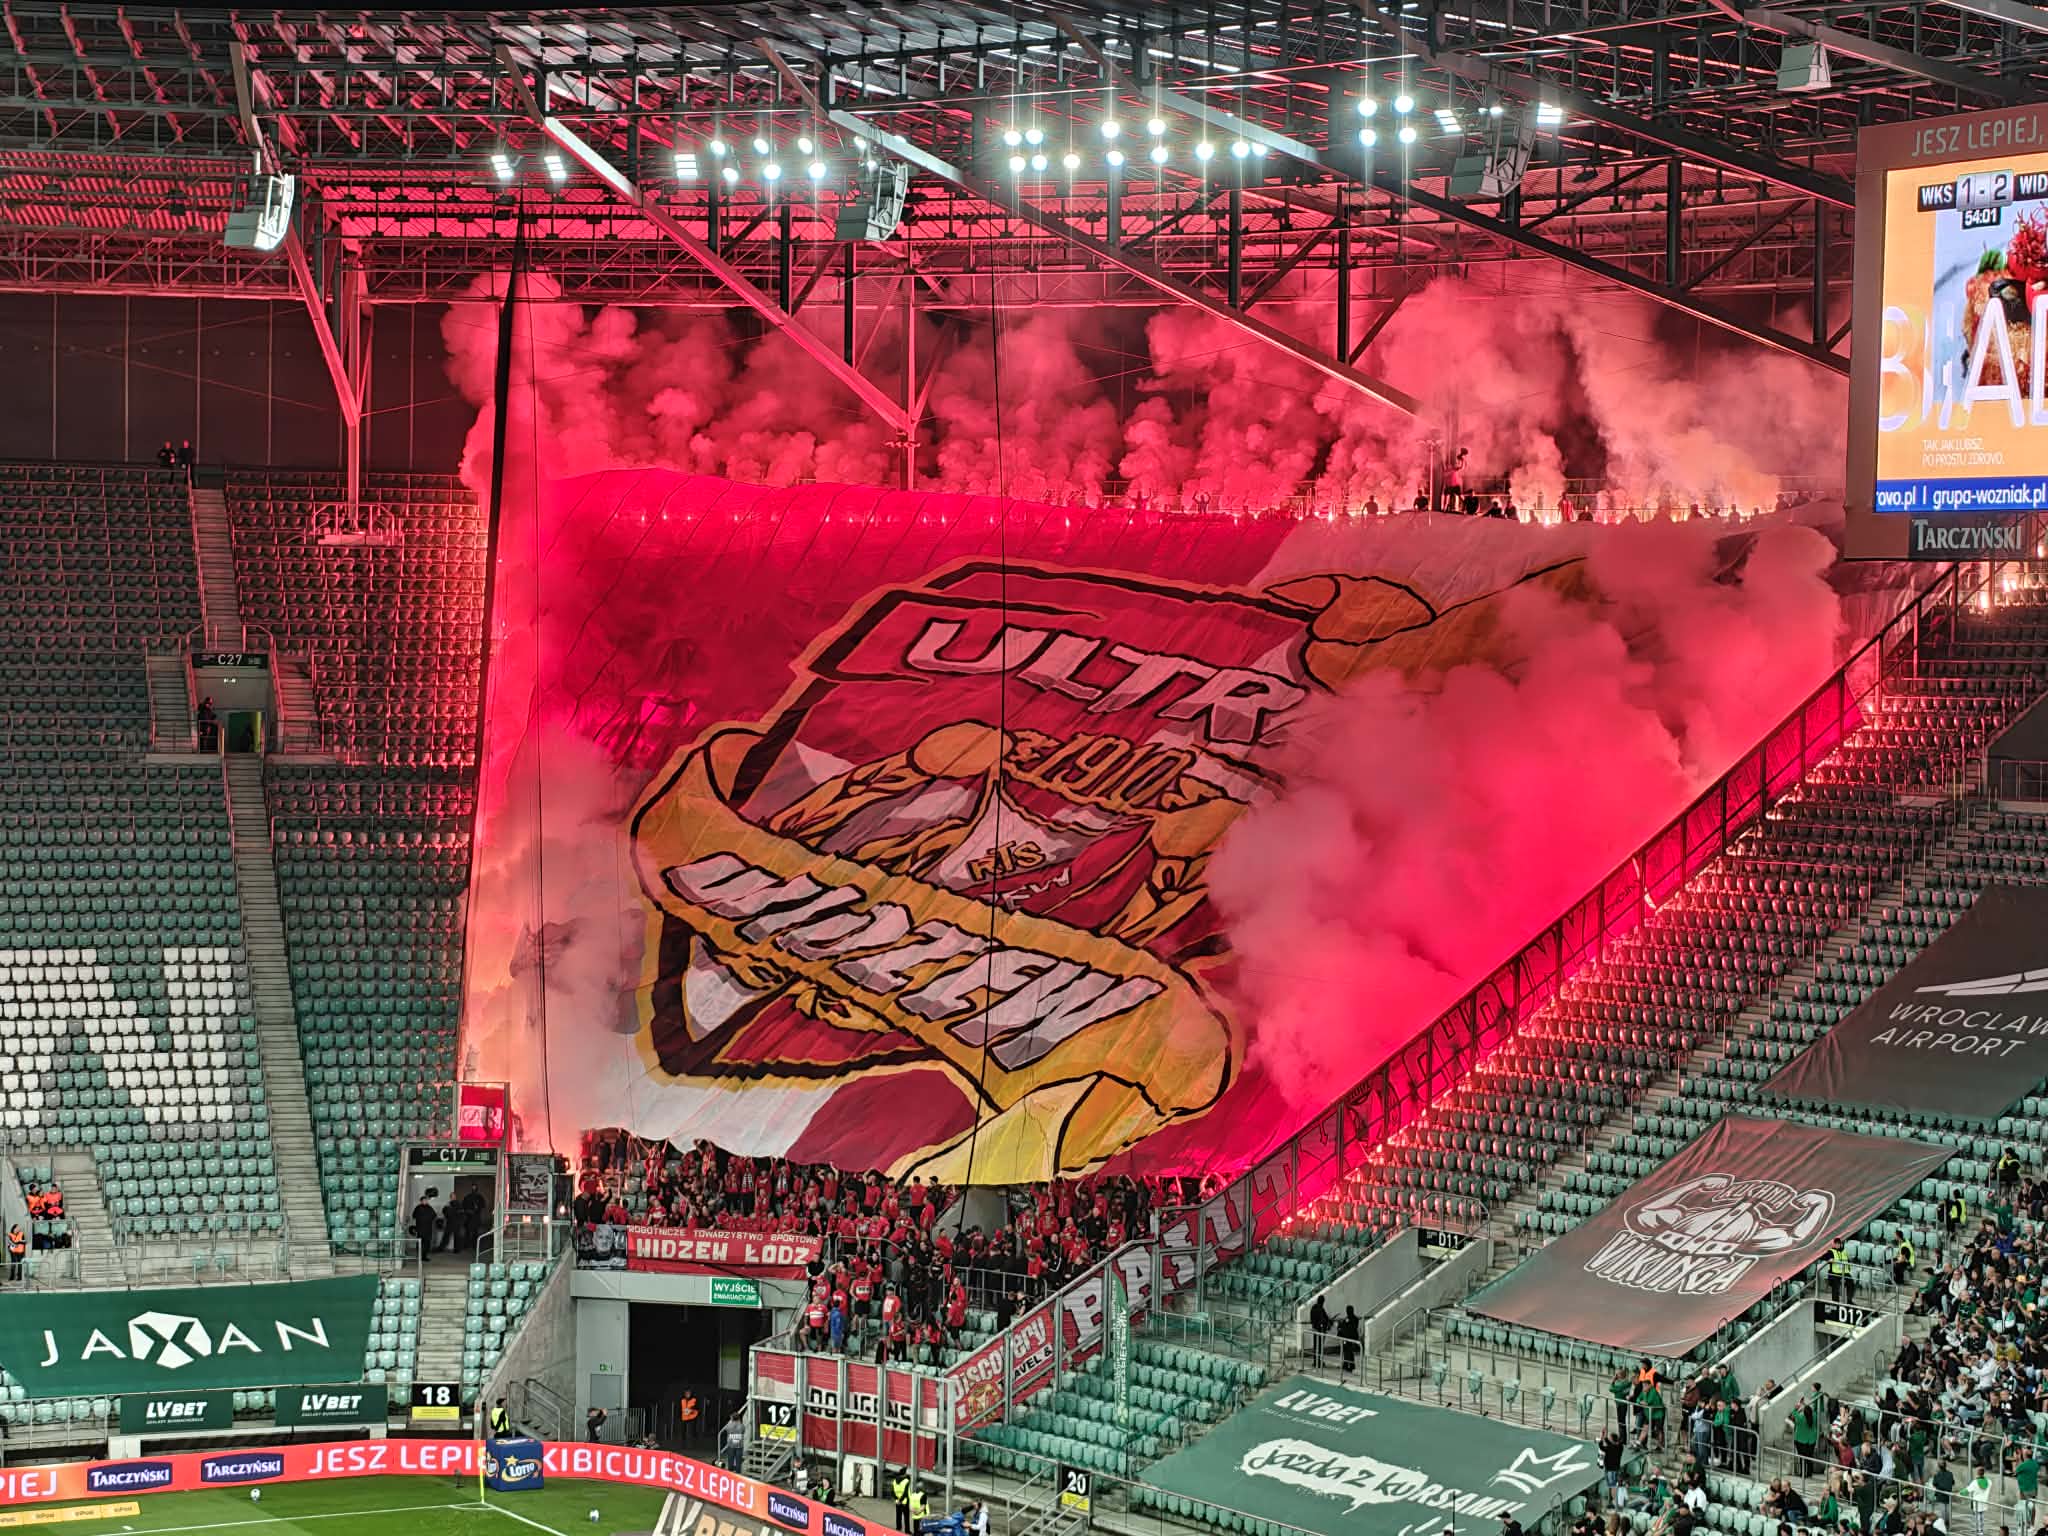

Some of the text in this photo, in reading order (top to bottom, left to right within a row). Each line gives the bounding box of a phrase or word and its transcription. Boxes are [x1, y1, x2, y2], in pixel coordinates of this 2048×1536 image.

[1912, 115, 2044, 157] JESZ LEPIEJ,
[1921, 185, 1952, 206] WKS
[1965, 208, 1998, 226] 54:01
[1933, 482, 2047, 510] grupa-wozniak.pl
[1912, 519, 2021, 551] TARCZYŃSKI
[218, 654, 242, 665] C27
[904, 618, 1310, 746] ULTR
[1033, 732, 1198, 807] 1910
[967, 841, 1046, 881] RTS
[661, 850, 1168, 1073] WIDZEW
[1870, 1027, 2027, 1056] AIRPORT
[440, 1148, 468, 1161] C17
[694, 1230, 763, 1242] TOWARZYSTWO
[1439, 1231, 1458, 1249] D11
[636, 1238, 728, 1262] WIDZEW
[1584, 1230, 1759, 1295] VIKINGA
[714, 1282, 757, 1293] WYJŚCIE
[1839, 1306, 1863, 1328] D12
[422, 1386, 450, 1405] 18
[768, 1405, 792, 1425] 19
[204, 1460, 281, 1479] TARCZYŃSKI
[509, 1462, 535, 1478] LOTTO
[1249, 1445, 1351, 1481] jazda
[90, 1468, 170, 1488] TARCZYŃSKI
[308, 1445, 388, 1474] JESZ
[700, 1468, 754, 1509] LEPIEJ
[1068, 1470, 1086, 1494] 20
[769, 1497, 808, 1525] TARCZYŃSKI
